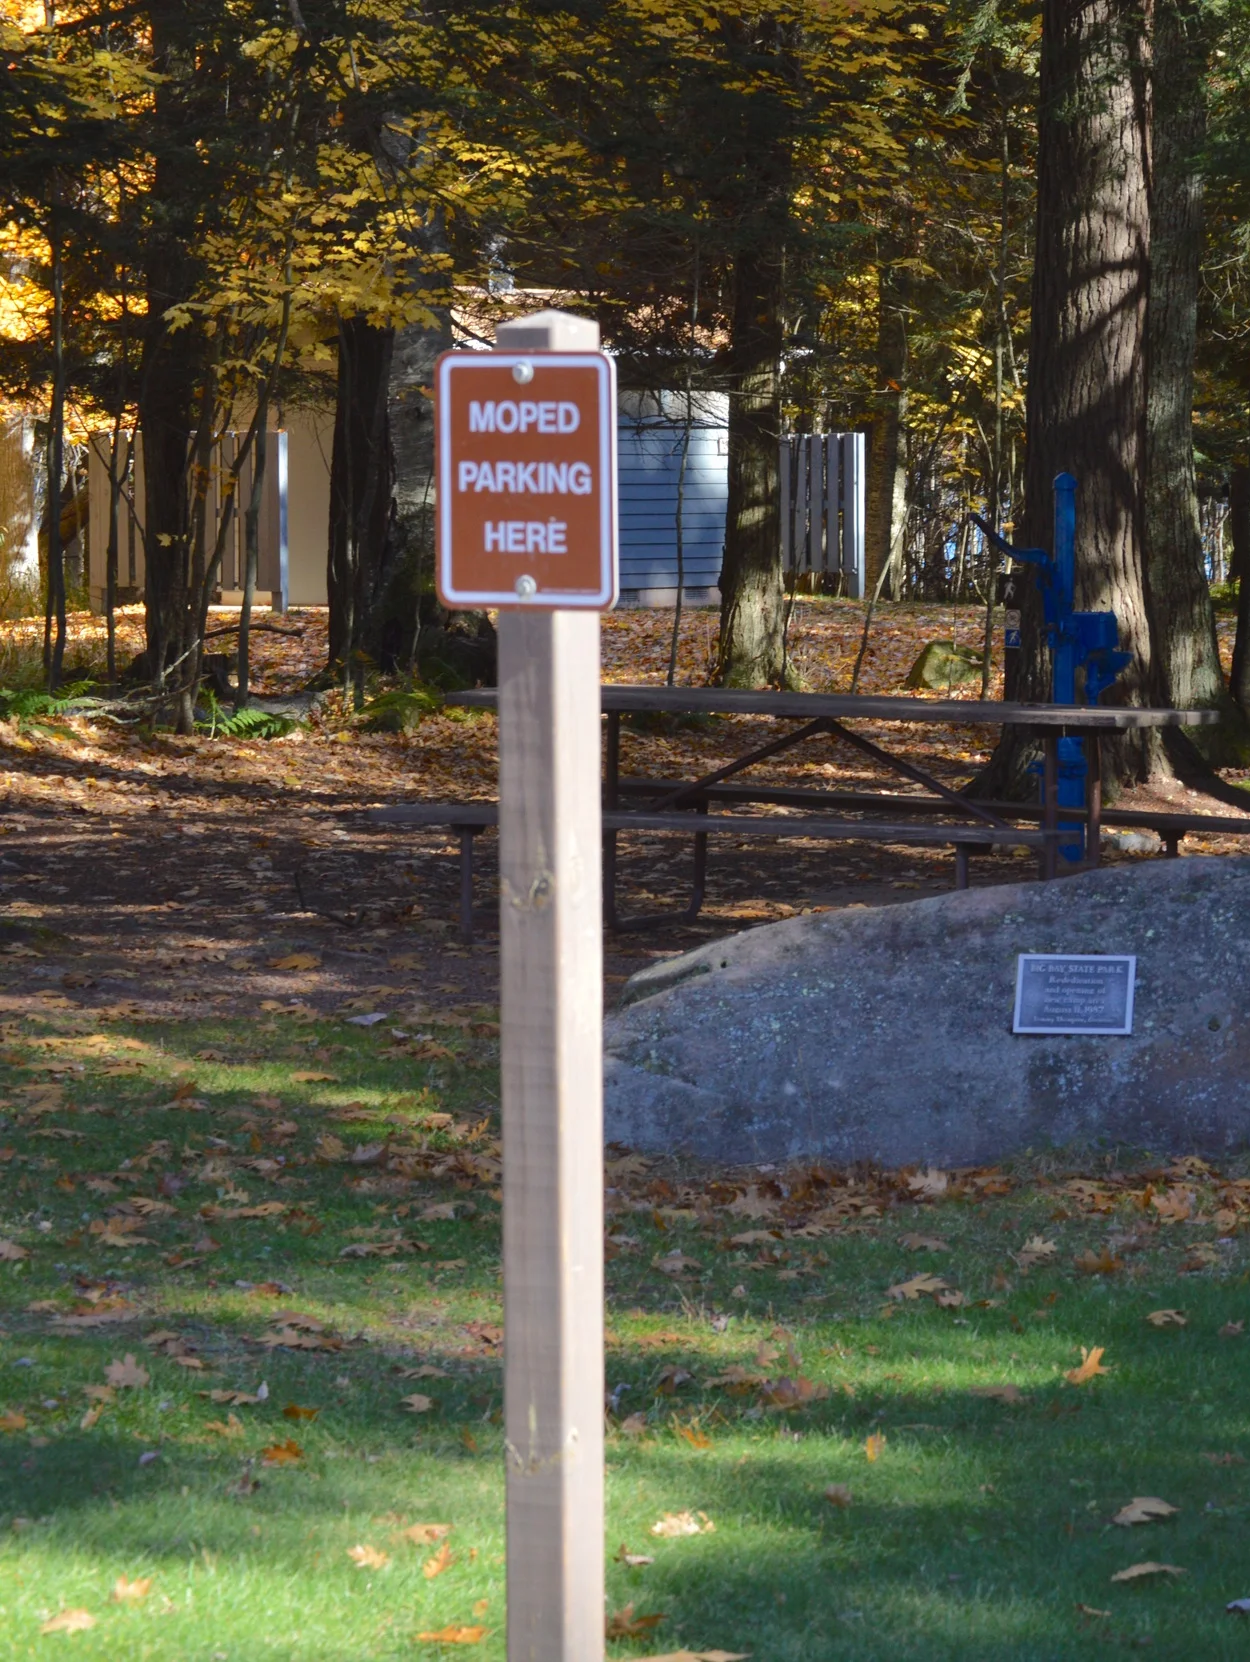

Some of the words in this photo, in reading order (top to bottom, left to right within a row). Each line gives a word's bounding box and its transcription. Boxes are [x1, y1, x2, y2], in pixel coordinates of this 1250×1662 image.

[468, 401, 580, 434] MOPED
[458, 460, 592, 495] PARKING
[484, 520, 568, 554] HERE
[1030, 964, 1046, 973] BIG
[1048, 964, 1065, 973] BAY
[1068, 965, 1095, 973] STATE
[1097, 965, 1124, 974] PARK
